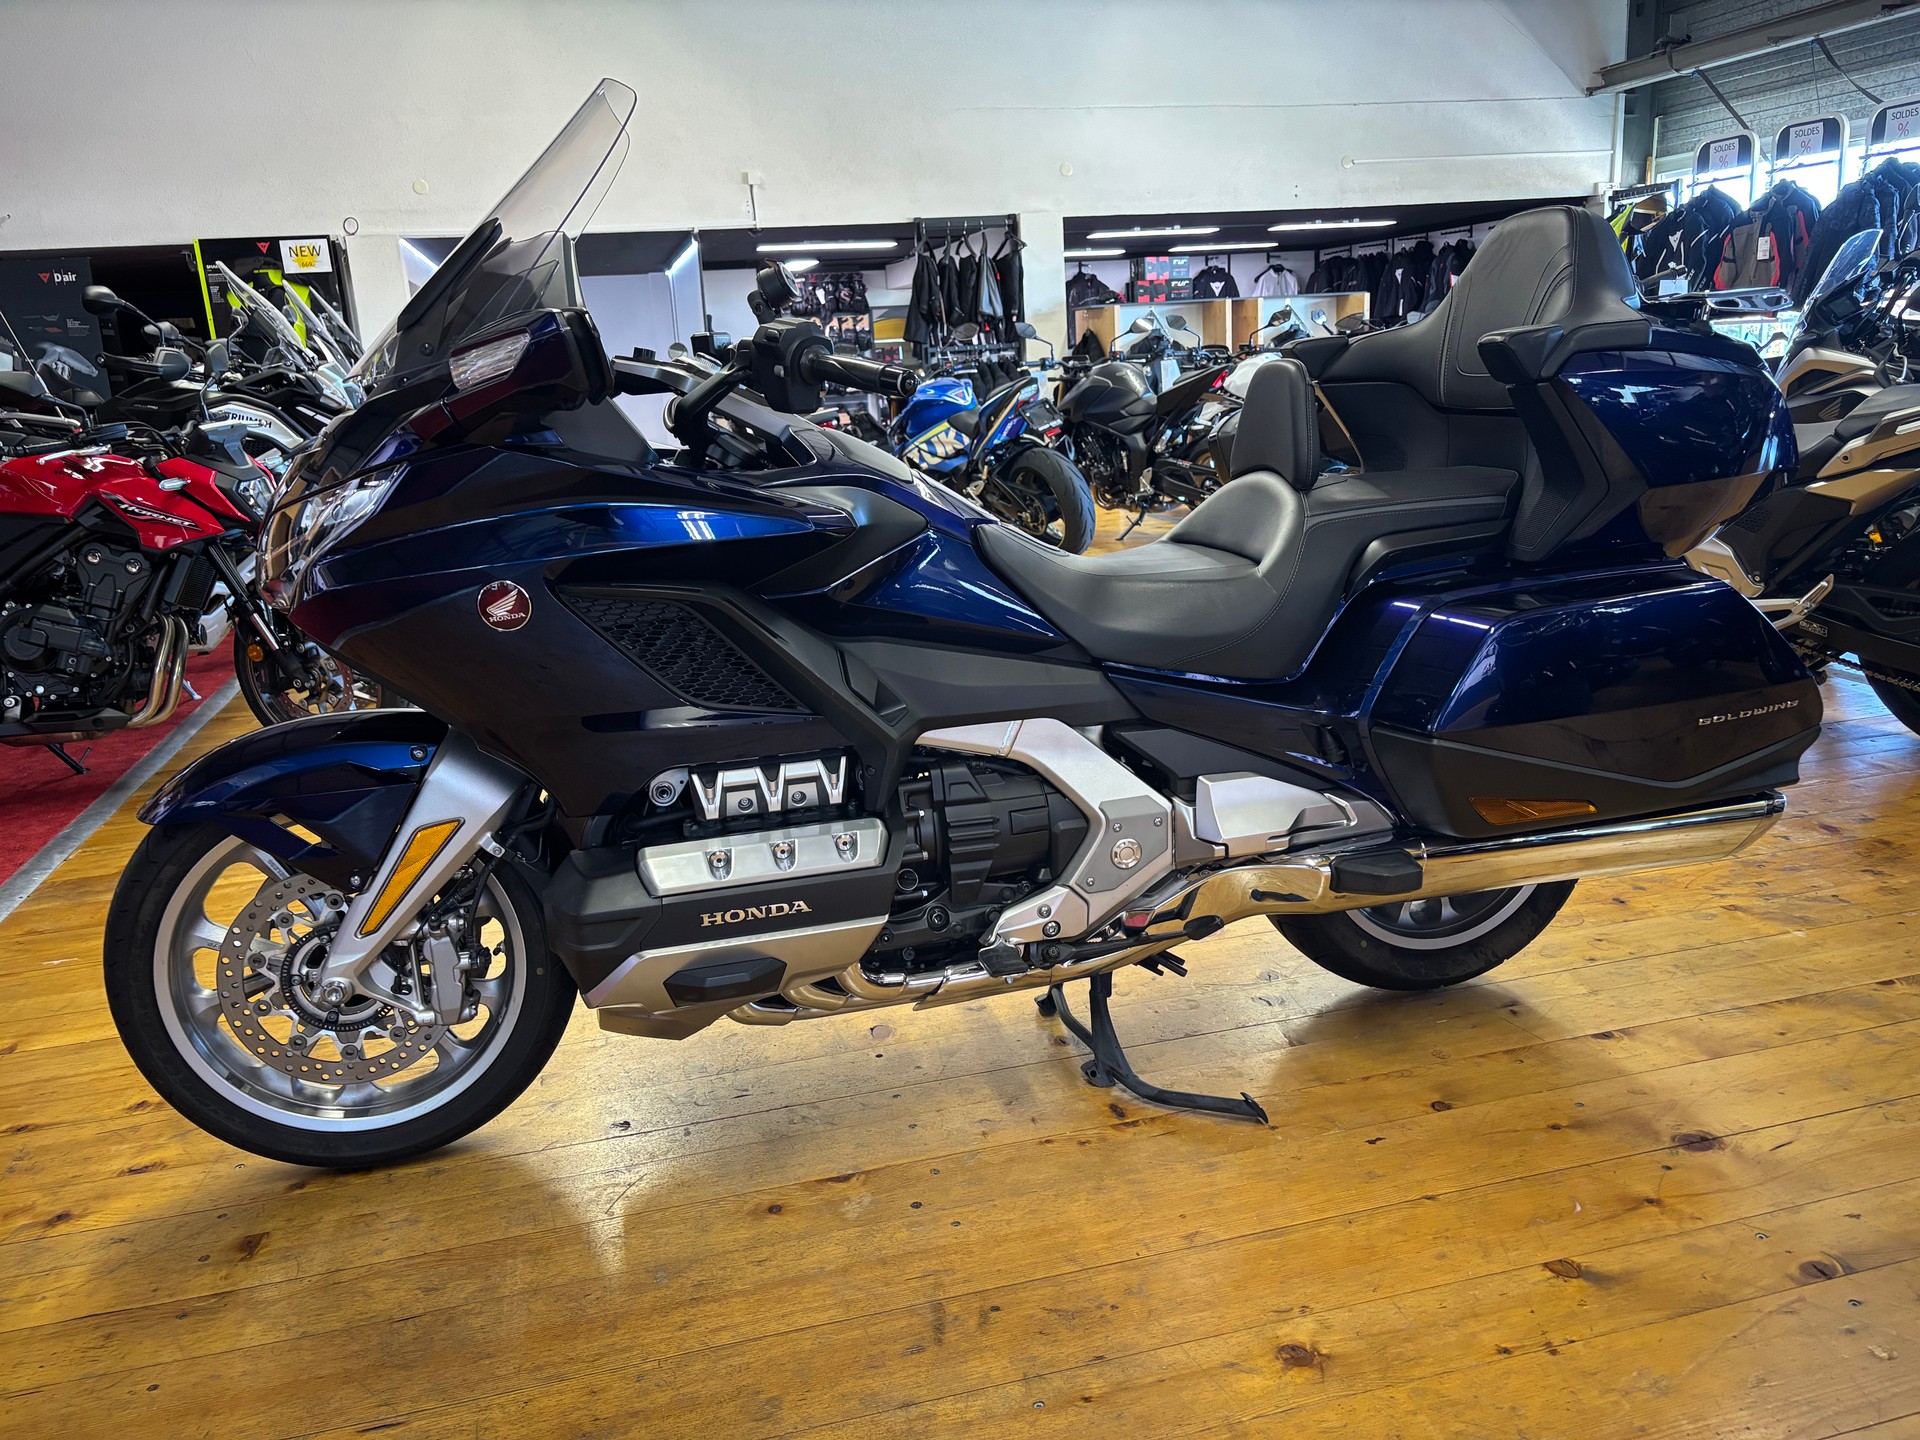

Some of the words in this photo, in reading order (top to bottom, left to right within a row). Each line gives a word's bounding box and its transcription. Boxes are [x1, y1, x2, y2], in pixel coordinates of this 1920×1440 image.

[1891, 107, 1919, 120] SOLDES
[1794, 126, 1820, 138] SOLDES
[1898, 121, 1910, 138] %
[1713, 142, 1736, 154] SOLDES
[1800, 139, 1812, 154] %
[1718, 154, 1729, 168] %
[288, 245, 321, 257] NEW
[119, 503, 195, 526] HORNET
[488, 612, 527, 623] HONDA
[1698, 699, 1799, 727] GOLDWING
[700, 900, 812, 927] HONDA
